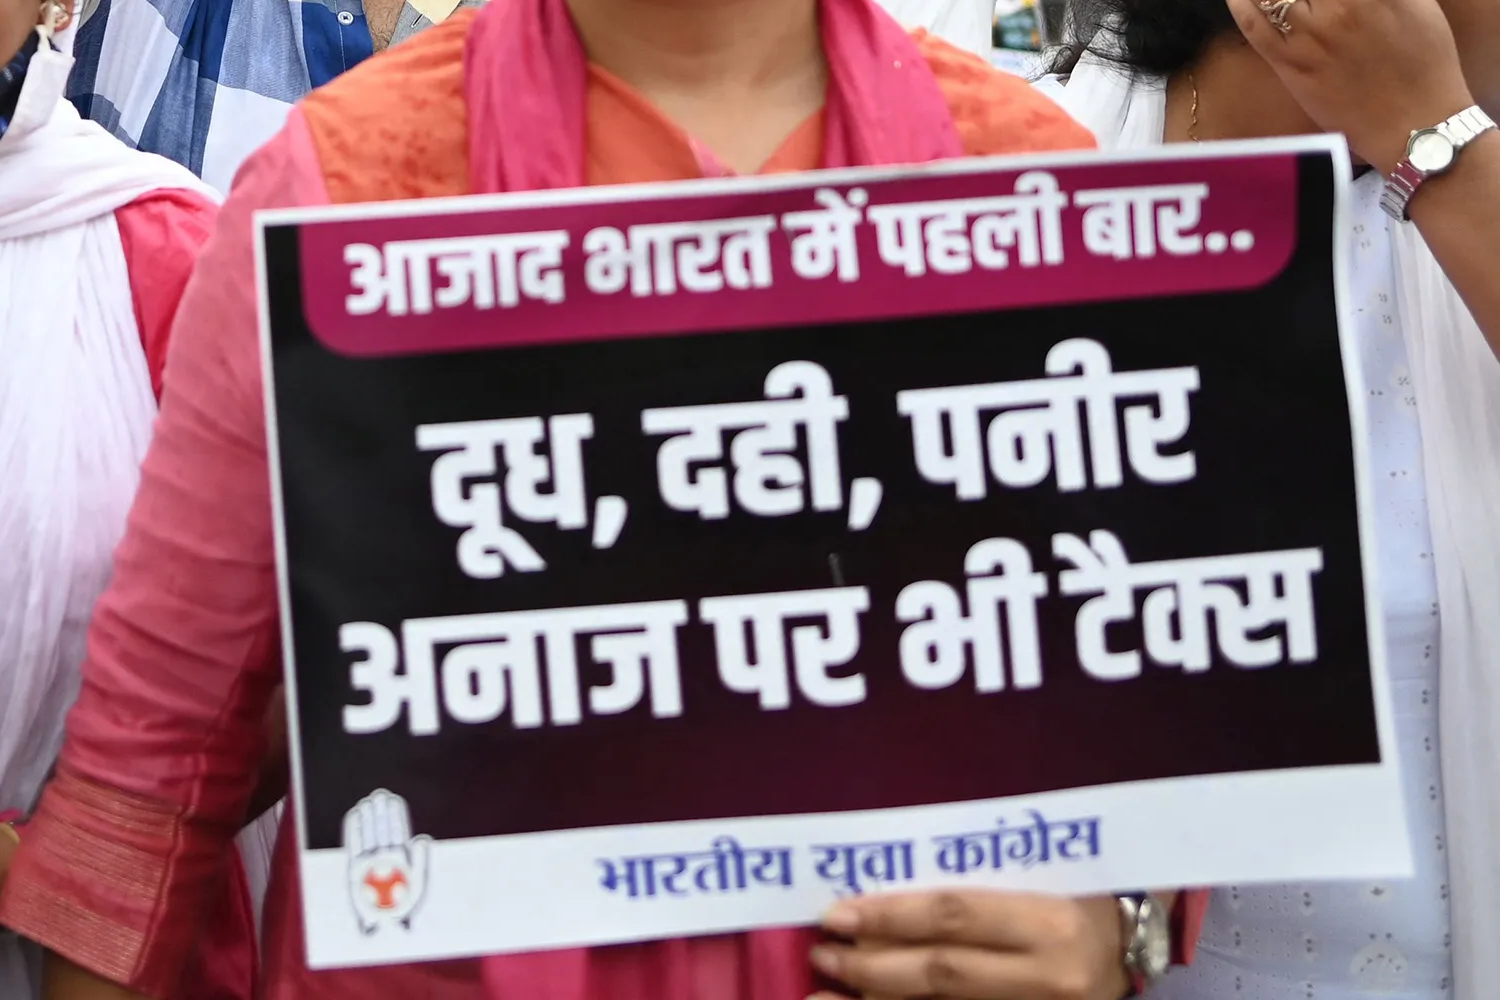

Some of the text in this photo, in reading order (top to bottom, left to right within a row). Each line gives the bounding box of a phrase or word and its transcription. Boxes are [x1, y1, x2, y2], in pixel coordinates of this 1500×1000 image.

[343, 172, 1255, 317] आजाद भारत में पहली बार..
[415, 337, 1200, 578] दूध, दही, पनीर
[338, 529, 1324, 737] अनाज पर भी टैक्स
[597, 808, 1104, 902] भारतीय युवा कांग्रेस
